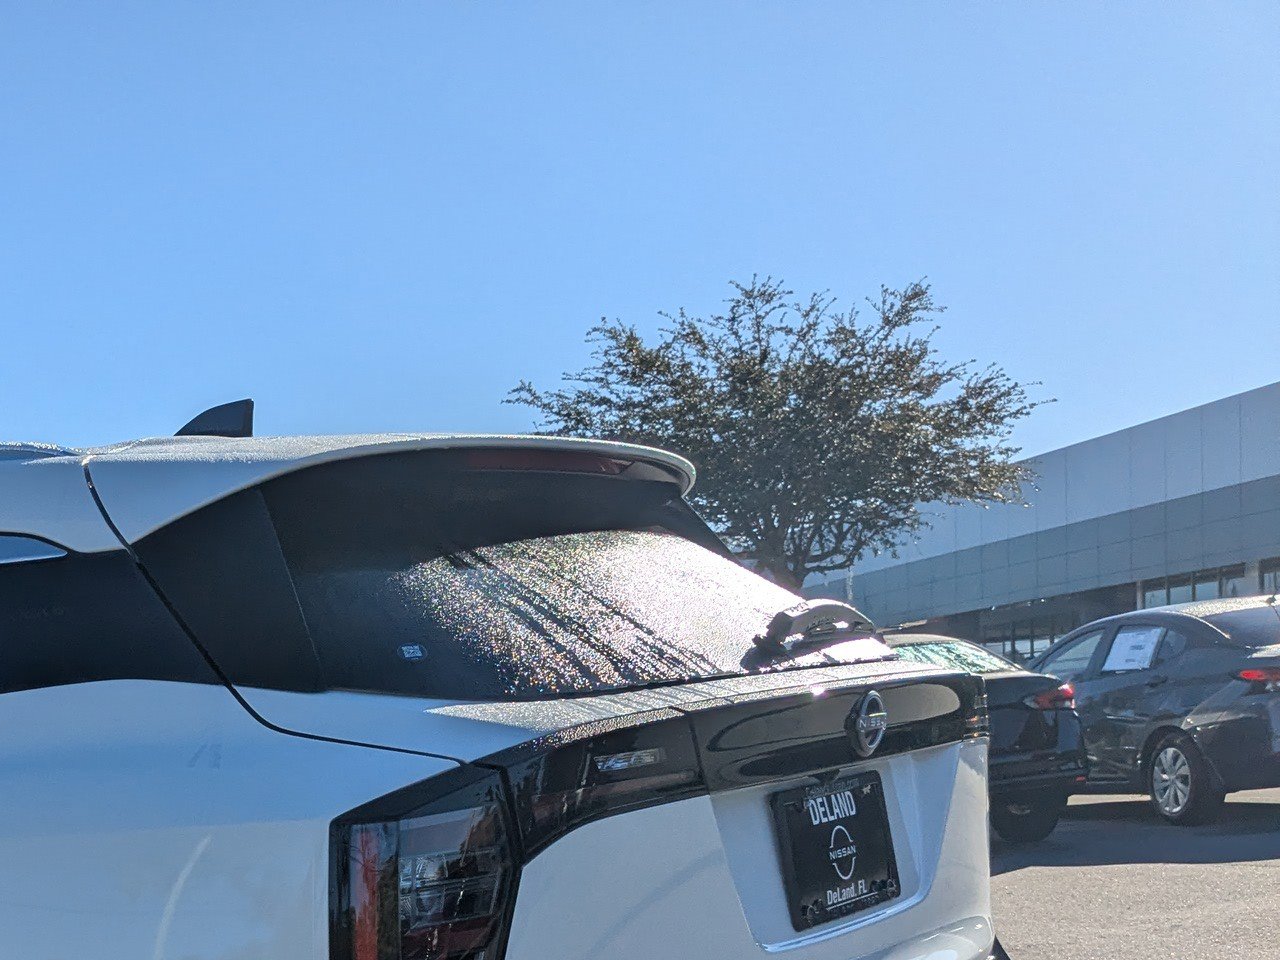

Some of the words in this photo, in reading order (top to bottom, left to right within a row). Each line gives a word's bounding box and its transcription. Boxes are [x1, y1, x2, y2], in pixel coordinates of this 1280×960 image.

[808, 791, 856, 826] DELAND
[829, 845, 856, 860] NISSAN
[858, 878, 869, 896] FL
